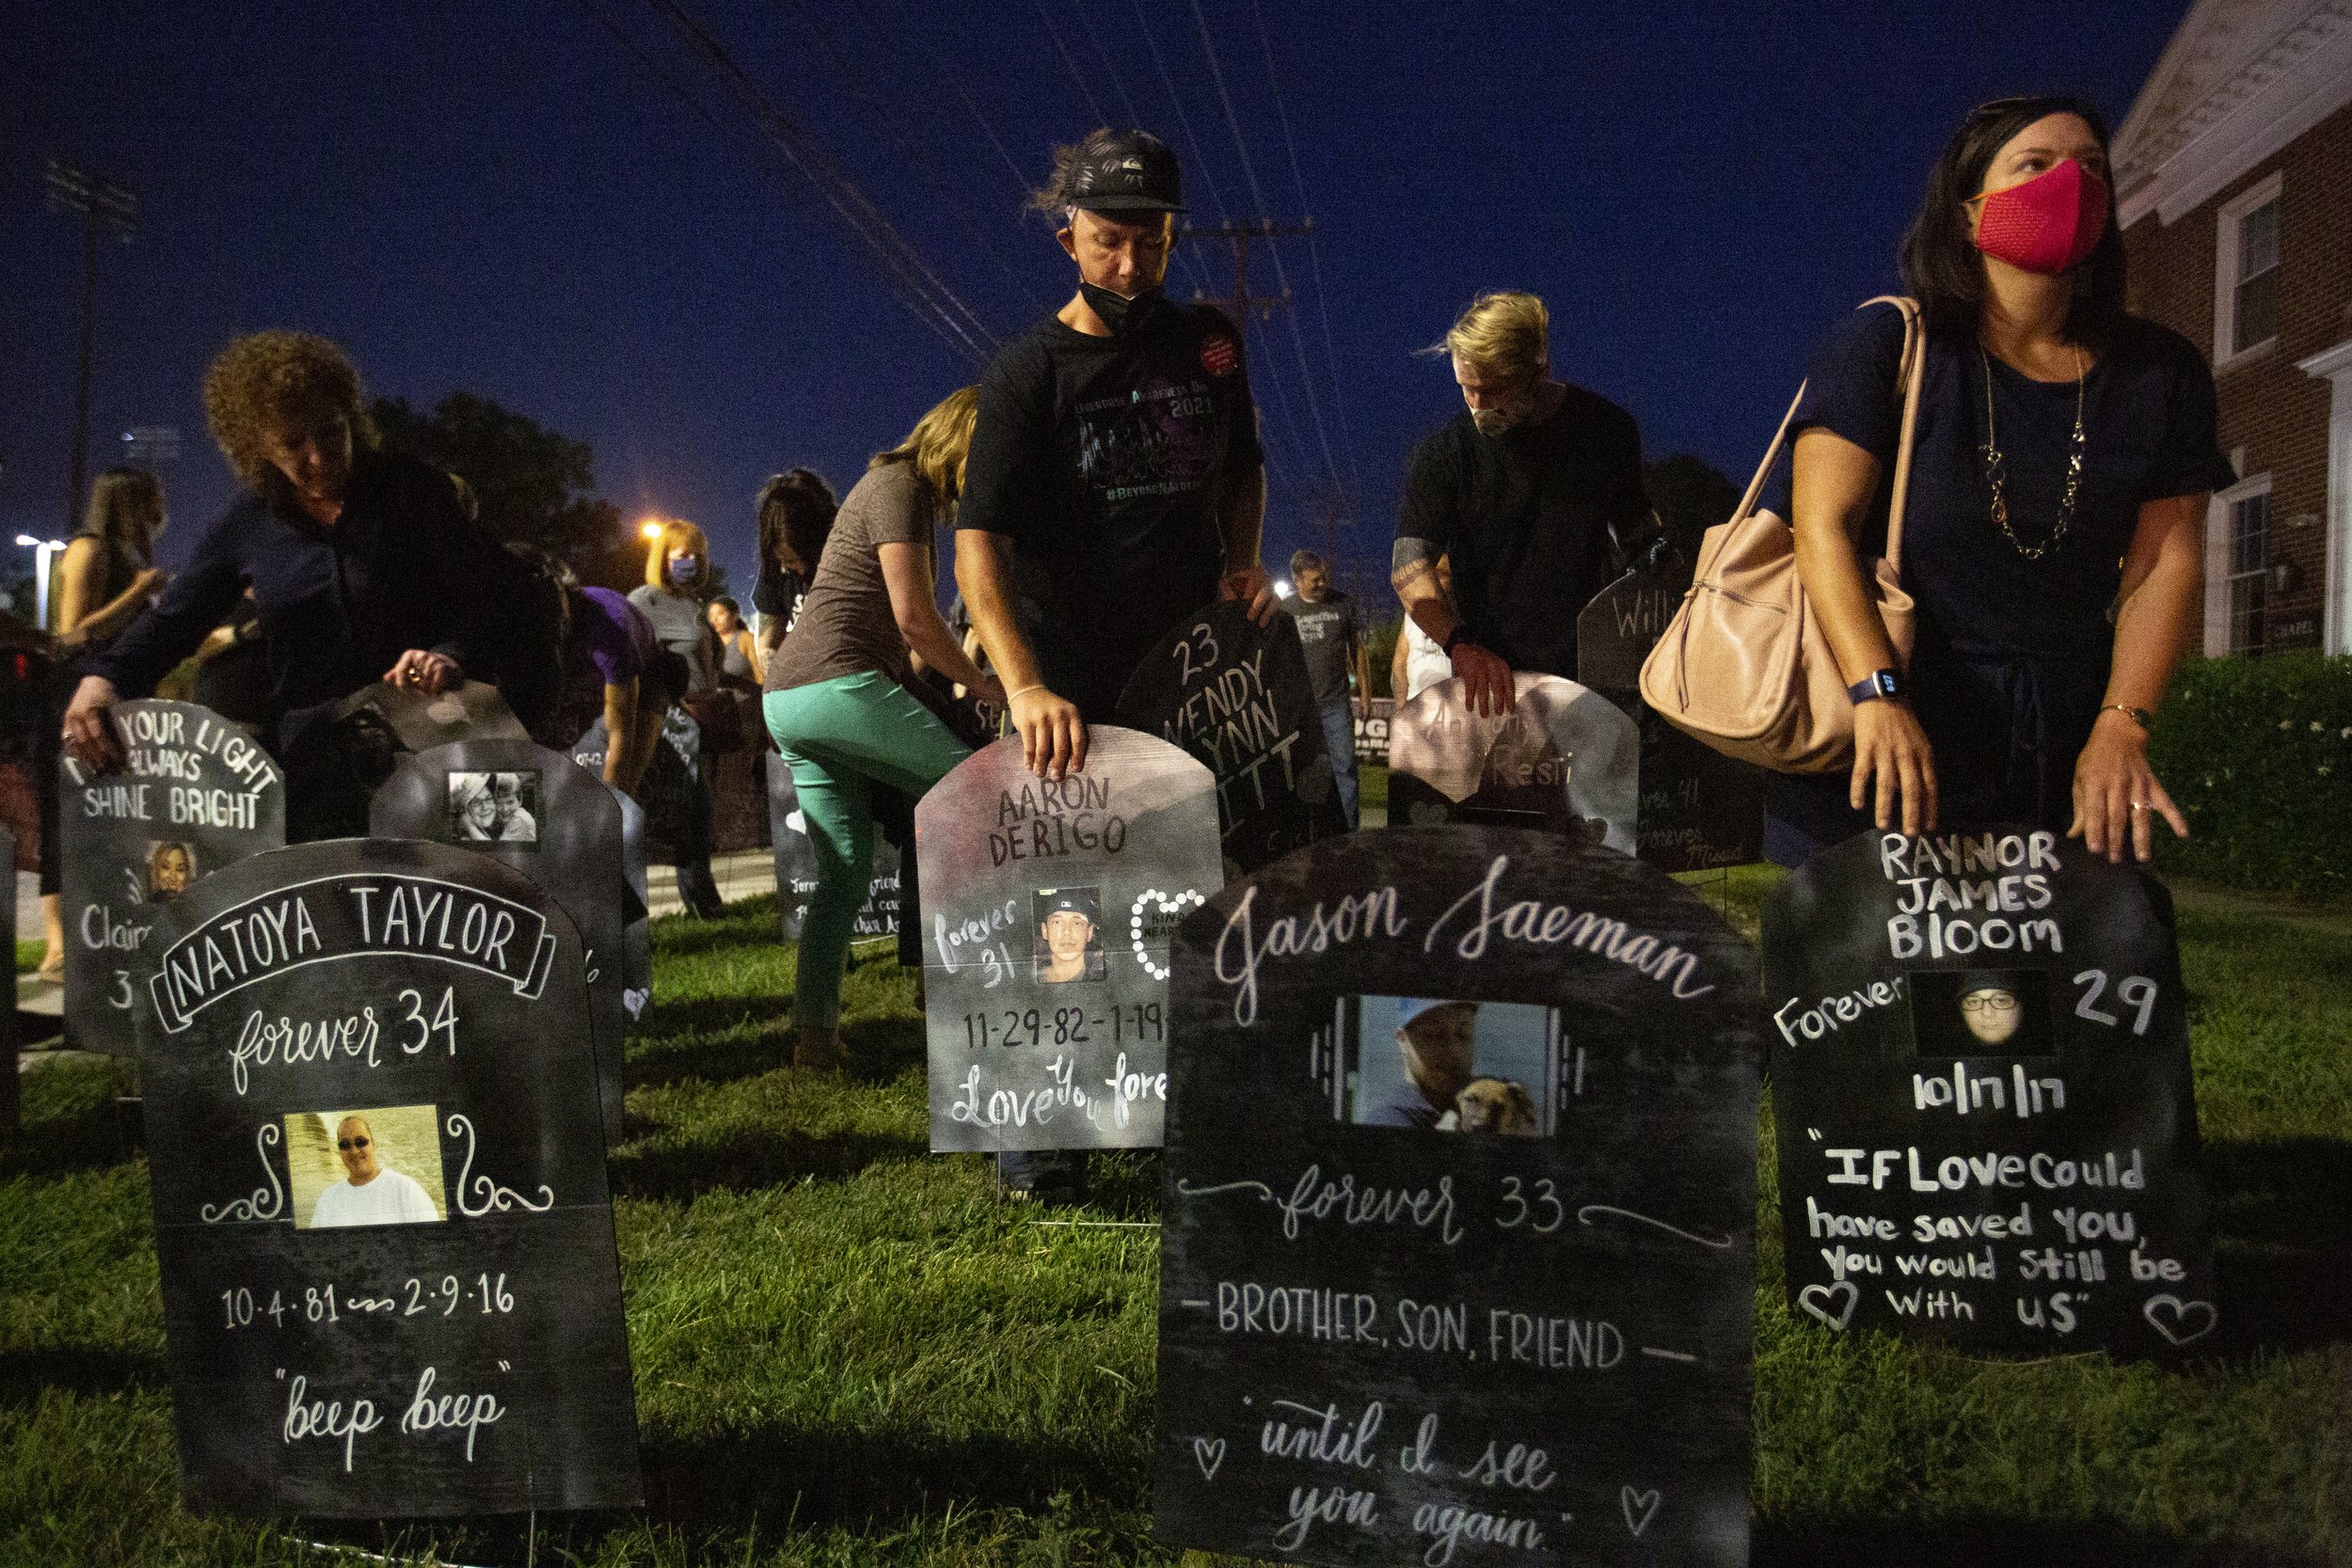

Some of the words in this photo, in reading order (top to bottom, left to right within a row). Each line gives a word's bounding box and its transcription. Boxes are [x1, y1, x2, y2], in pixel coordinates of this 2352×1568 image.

[1169, 396, 1214, 419] 2021
[1172, 623, 1219, 686] 23
[119, 711, 185, 746] YOUR
[195, 720, 278, 794] LIGHT
[1201, 689, 1280, 776] YNN
[129, 749, 203, 782] ALWAYS
[84, 784, 153, 820] SHINE
[170, 786, 262, 830] BRIGHT
[997, 776, 1111, 828] AARON
[1880, 831, 2062, 880] RAYNOR
[1897, 875, 2052, 914] JAMES
[167, 897, 322, 1006] NATOYA
[351, 886, 515, 971] TAYLOR
[982, 943, 1015, 989] 31
[1215, 885, 1407, 1028] Jason
[1772, 975, 1905, 1048] Forever
[2073, 969, 2158, 1035] 29
[230, 1006, 381, 1096] forever
[398, 986, 459, 1056] 34
[951, 1064, 1055, 1128] Love
[1277, 1164, 1463, 1245] forever
[1496, 1177, 1565, 1233] 33
[1806, 1196, 1900, 1241] have
[1914, 1203, 2033, 1243] saved
[1897, 1244, 1995, 1280] would
[2131, 1250, 2185, 1281] be
[1218, 1282, 1388, 1347] BROTHER,
[1398, 1298, 1477, 1360] SON,
[1490, 1310, 1623, 1369] FRIEND
[1458, 1441, 1559, 1492] see
[1273, 1484, 1378, 1553] you
